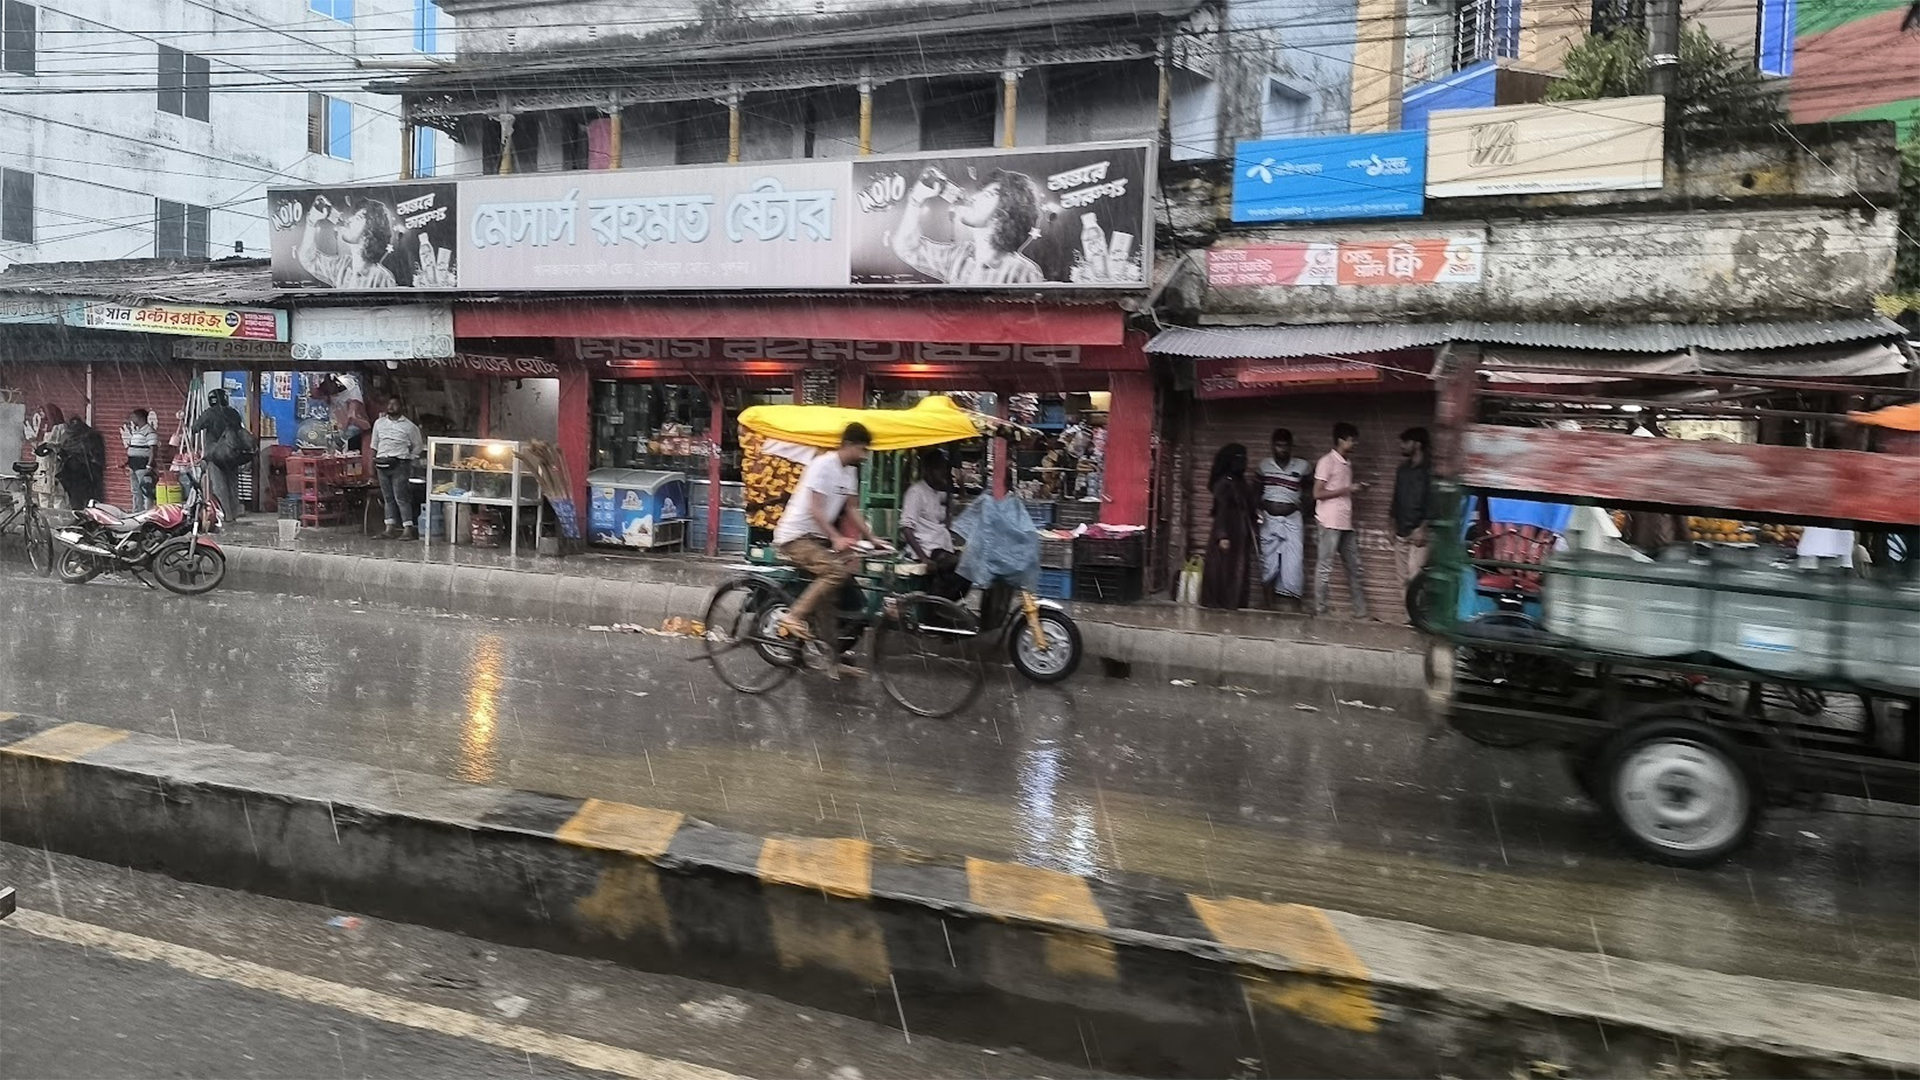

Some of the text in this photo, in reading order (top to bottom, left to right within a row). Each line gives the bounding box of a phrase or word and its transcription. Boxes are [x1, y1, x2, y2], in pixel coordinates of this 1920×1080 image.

[471, 176, 836, 249] মেসার্স রহমত ষ্টোর
[105, 307, 132, 321] সান
[135, 307, 223, 329] এন্টারপ্রাইজ
